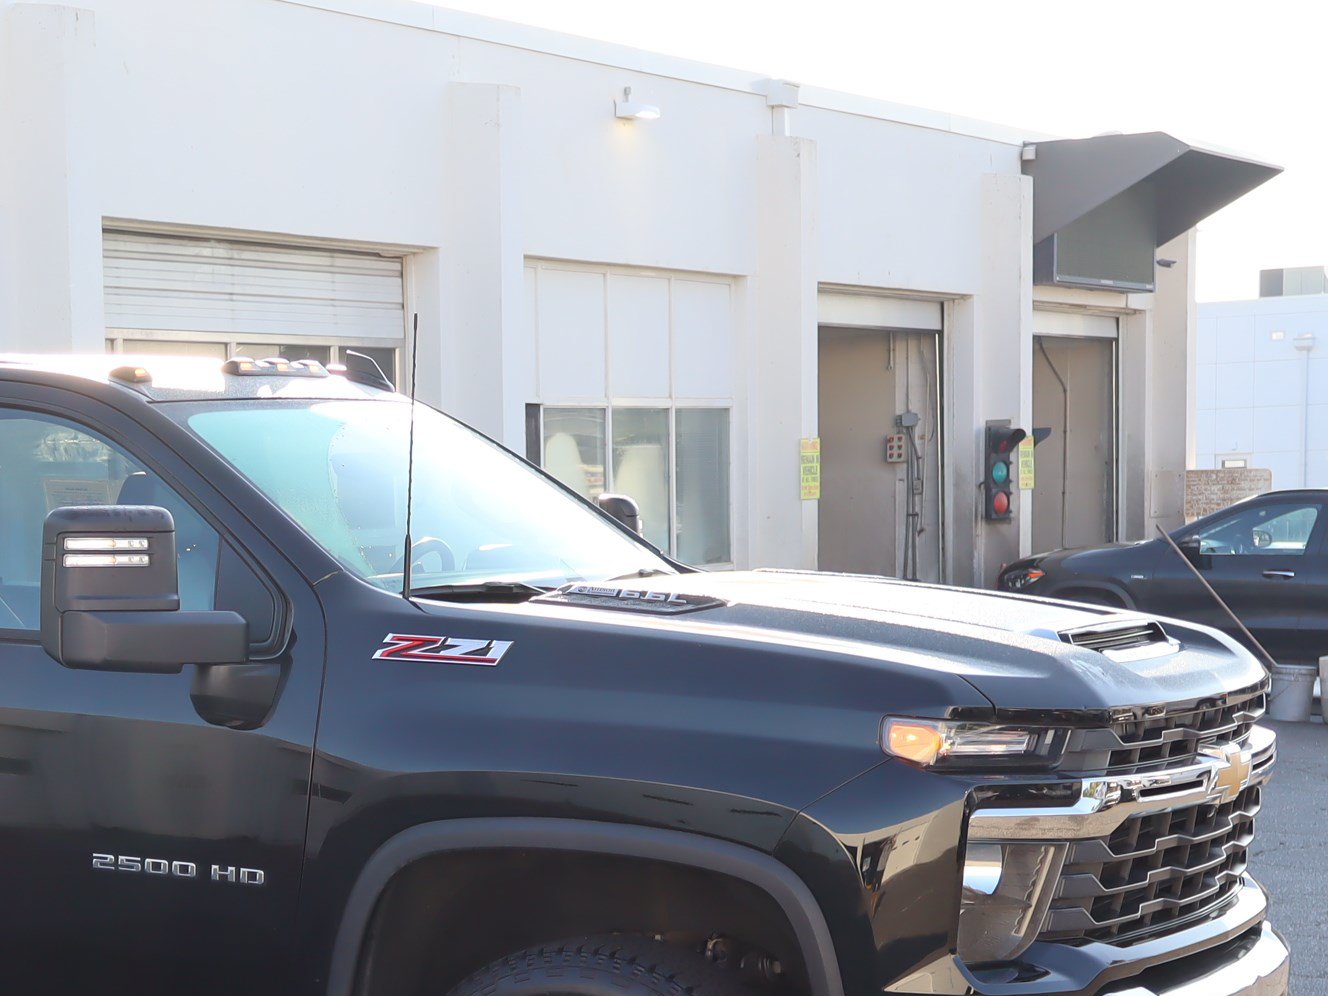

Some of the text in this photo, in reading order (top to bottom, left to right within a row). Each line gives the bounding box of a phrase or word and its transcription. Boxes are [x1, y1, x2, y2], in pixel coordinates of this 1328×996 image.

[619, 589, 687, 604] 6.6L
[372, 632, 515, 666] Z71
[92, 852, 265, 885] 2500 HD
